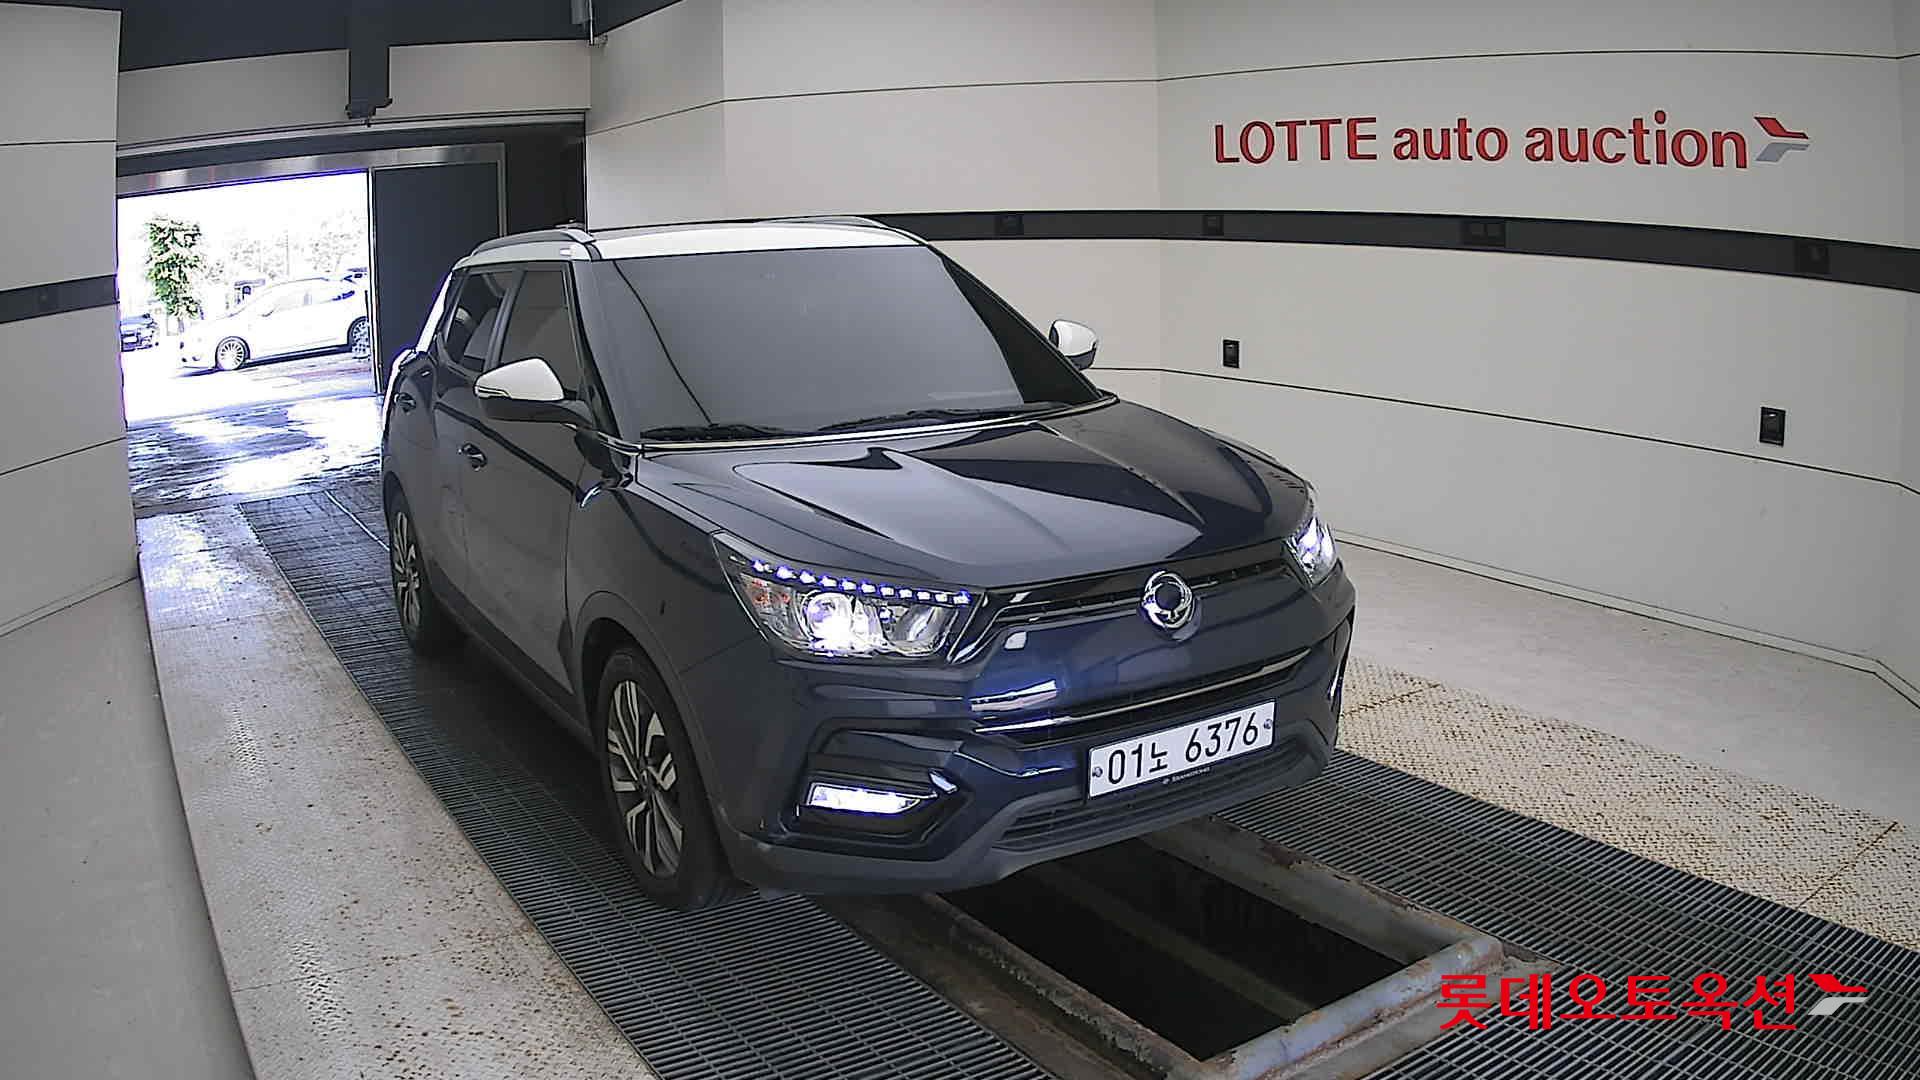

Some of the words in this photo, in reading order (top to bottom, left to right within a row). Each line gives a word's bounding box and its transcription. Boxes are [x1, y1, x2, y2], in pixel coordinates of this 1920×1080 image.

[1214, 117, 1377, 164] LOTTE
[1393, 117, 1509, 162] auto
[1524, 110, 1748, 169] auction
[1107, 742, 1168, 785] 01노
[1185, 712, 1259, 763] 6376
